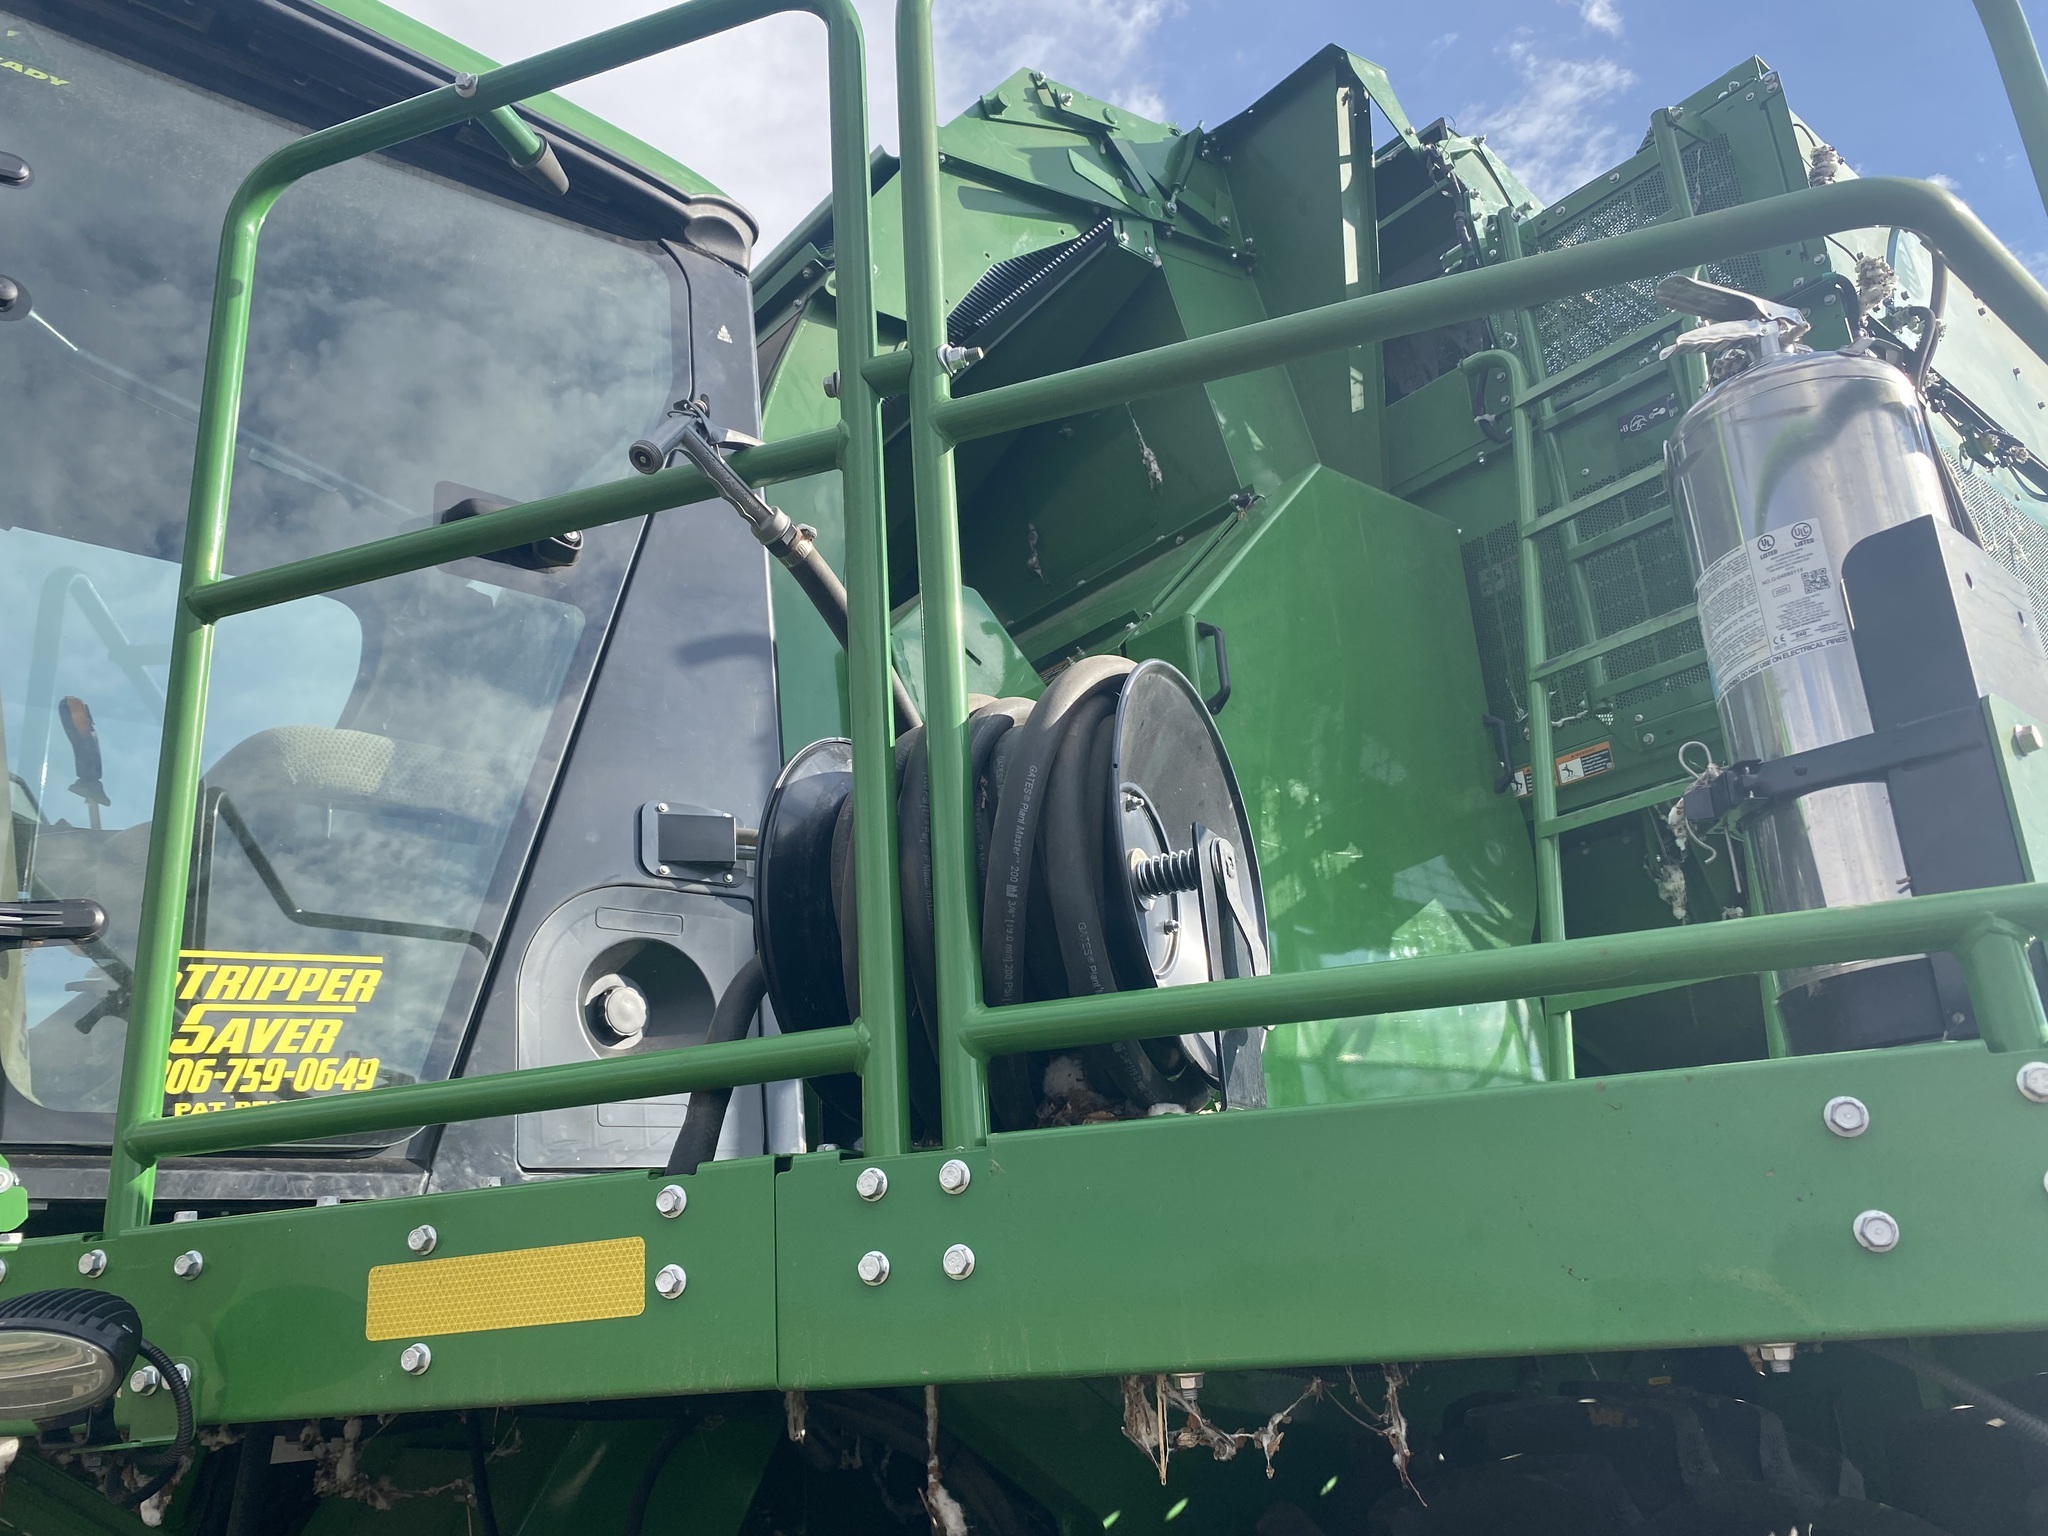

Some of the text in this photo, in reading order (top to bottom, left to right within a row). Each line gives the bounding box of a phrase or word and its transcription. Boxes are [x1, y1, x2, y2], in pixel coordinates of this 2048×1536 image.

[0, 56, 70, 86] ADY
[1794, 538, 1815, 548] LISTED
[1760, 549, 1778, 560] LISTED
[1748, 665, 1760, 676] NOT
[1759, 658, 1772, 670] USE
[1772, 653, 1783, 663] ON
[1782, 641, 1827, 661] ELECTRICAL
[1826, 635, 1848, 648] FIRES
[1016, 802, 1029, 823] Plant
[1009, 865, 1020, 883] 200
[1004, 963, 1014, 980] 200
[1089, 965, 1102, 987] Plant
[174, 963, 384, 1003] TRIPPER
[169, 1003, 352, 1054] SAVER
